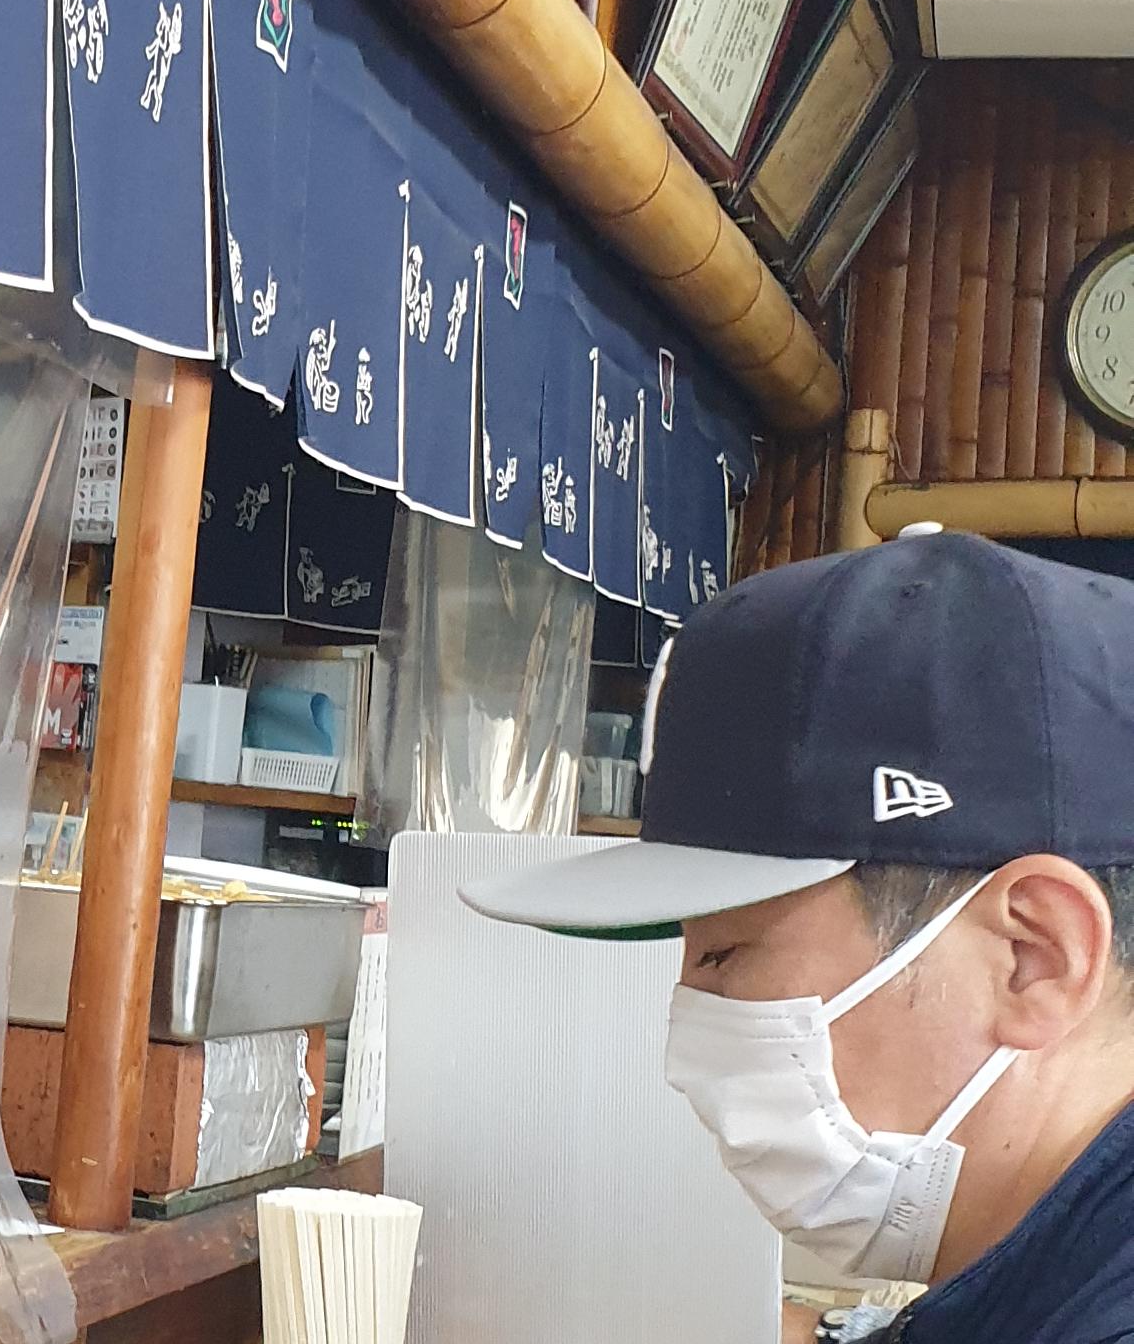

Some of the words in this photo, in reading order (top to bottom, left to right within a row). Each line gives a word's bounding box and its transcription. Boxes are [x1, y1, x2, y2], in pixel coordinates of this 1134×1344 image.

[1102, 289, 1125, 314] 10
[1095, 324, 1111, 344] 9
[1102, 355, 1119, 381] 8
